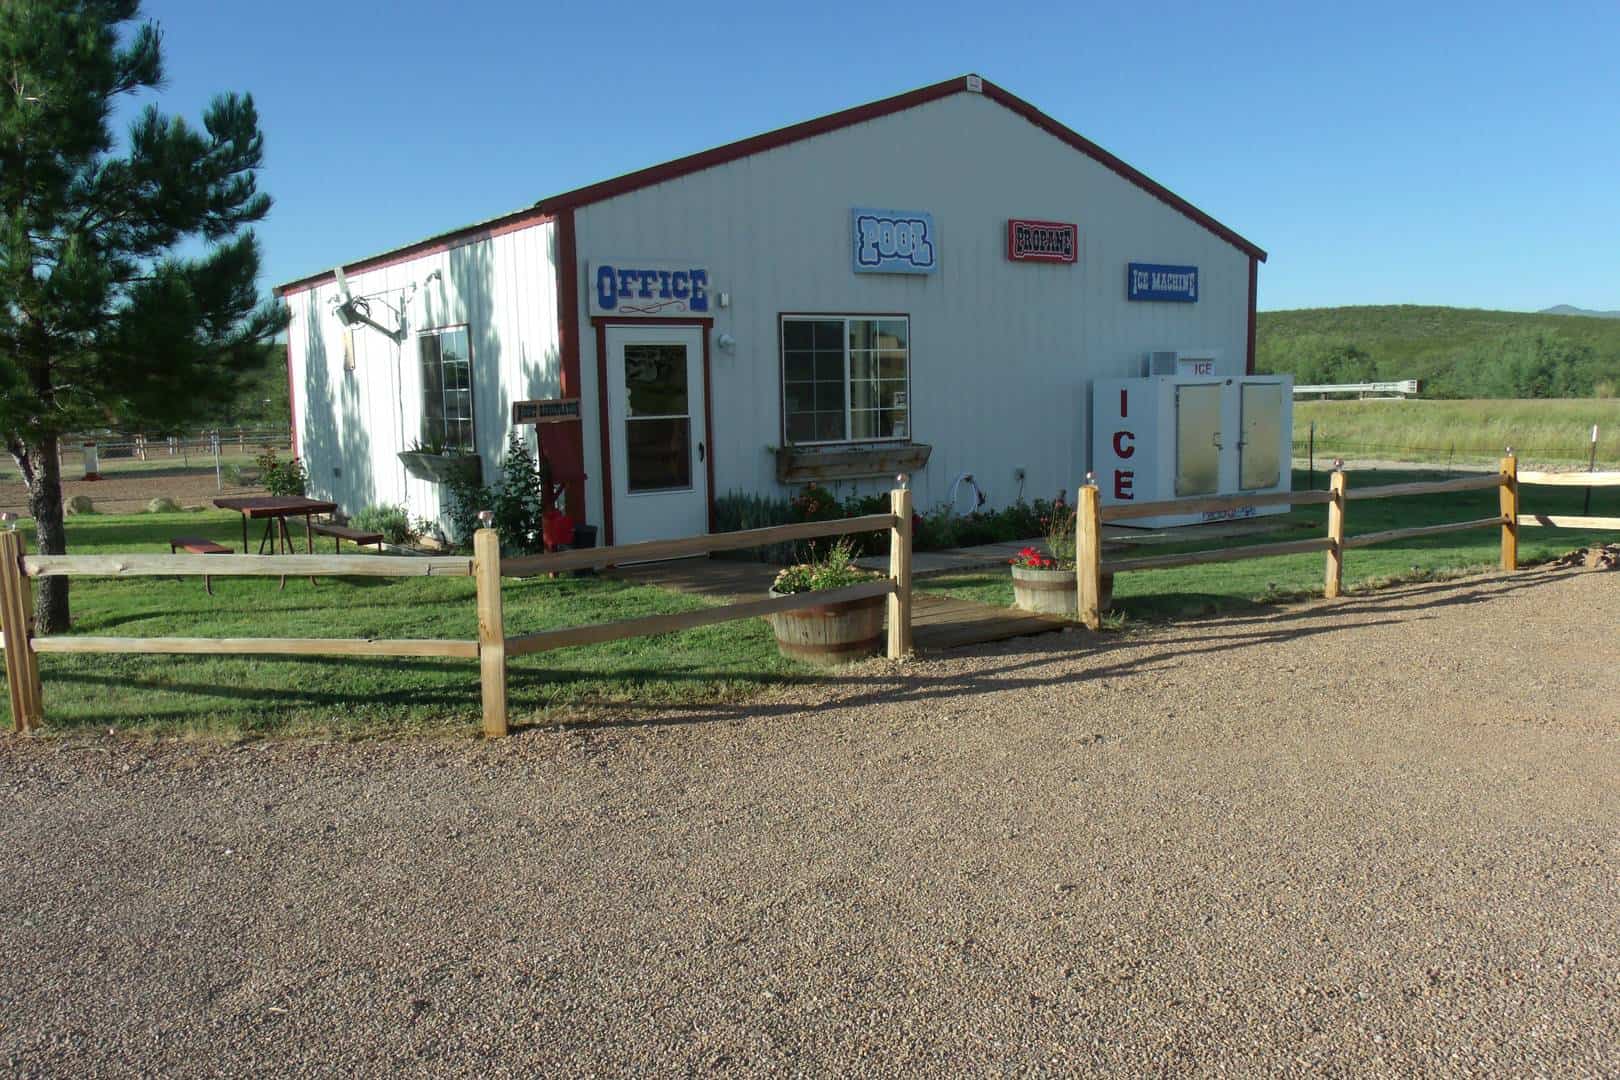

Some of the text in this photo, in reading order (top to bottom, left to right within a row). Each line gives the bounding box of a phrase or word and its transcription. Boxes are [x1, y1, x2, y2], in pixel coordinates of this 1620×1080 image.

[859, 216, 933, 265] POOL
[1016, 226, 1072, 255] PROPANE
[597, 266, 708, 312] OFFICE
[1133, 269, 1195, 297] ICE MACHINE
[1194, 362, 1212, 375] ICE
[1112, 388, 1136, 500] ICE
